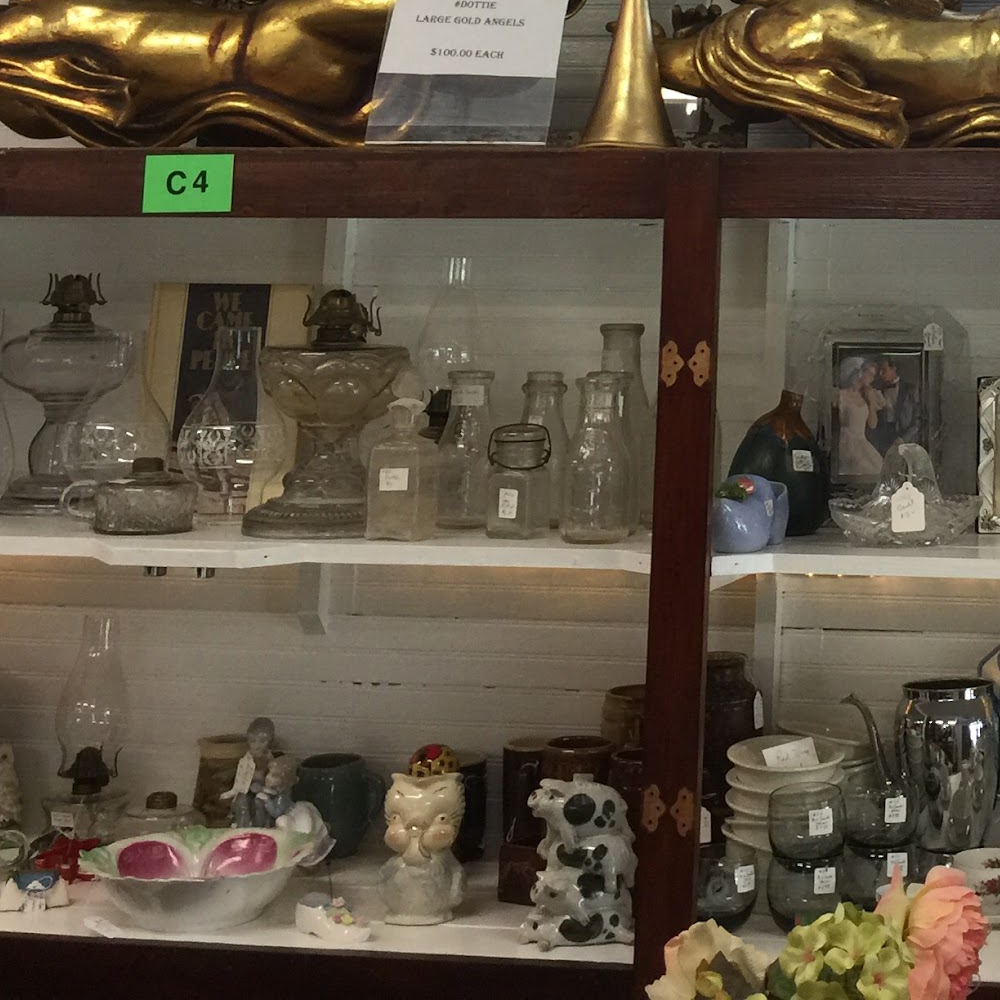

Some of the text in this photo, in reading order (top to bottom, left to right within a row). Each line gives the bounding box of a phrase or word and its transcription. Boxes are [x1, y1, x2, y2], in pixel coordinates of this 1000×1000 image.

[454, 0, 497, 10] #DOTTIE
[415, 15, 525, 27] LARGE GOLD ANGELS
[430, 47, 504, 59] $100.00 EACH
[213, 292, 241, 312] WE
